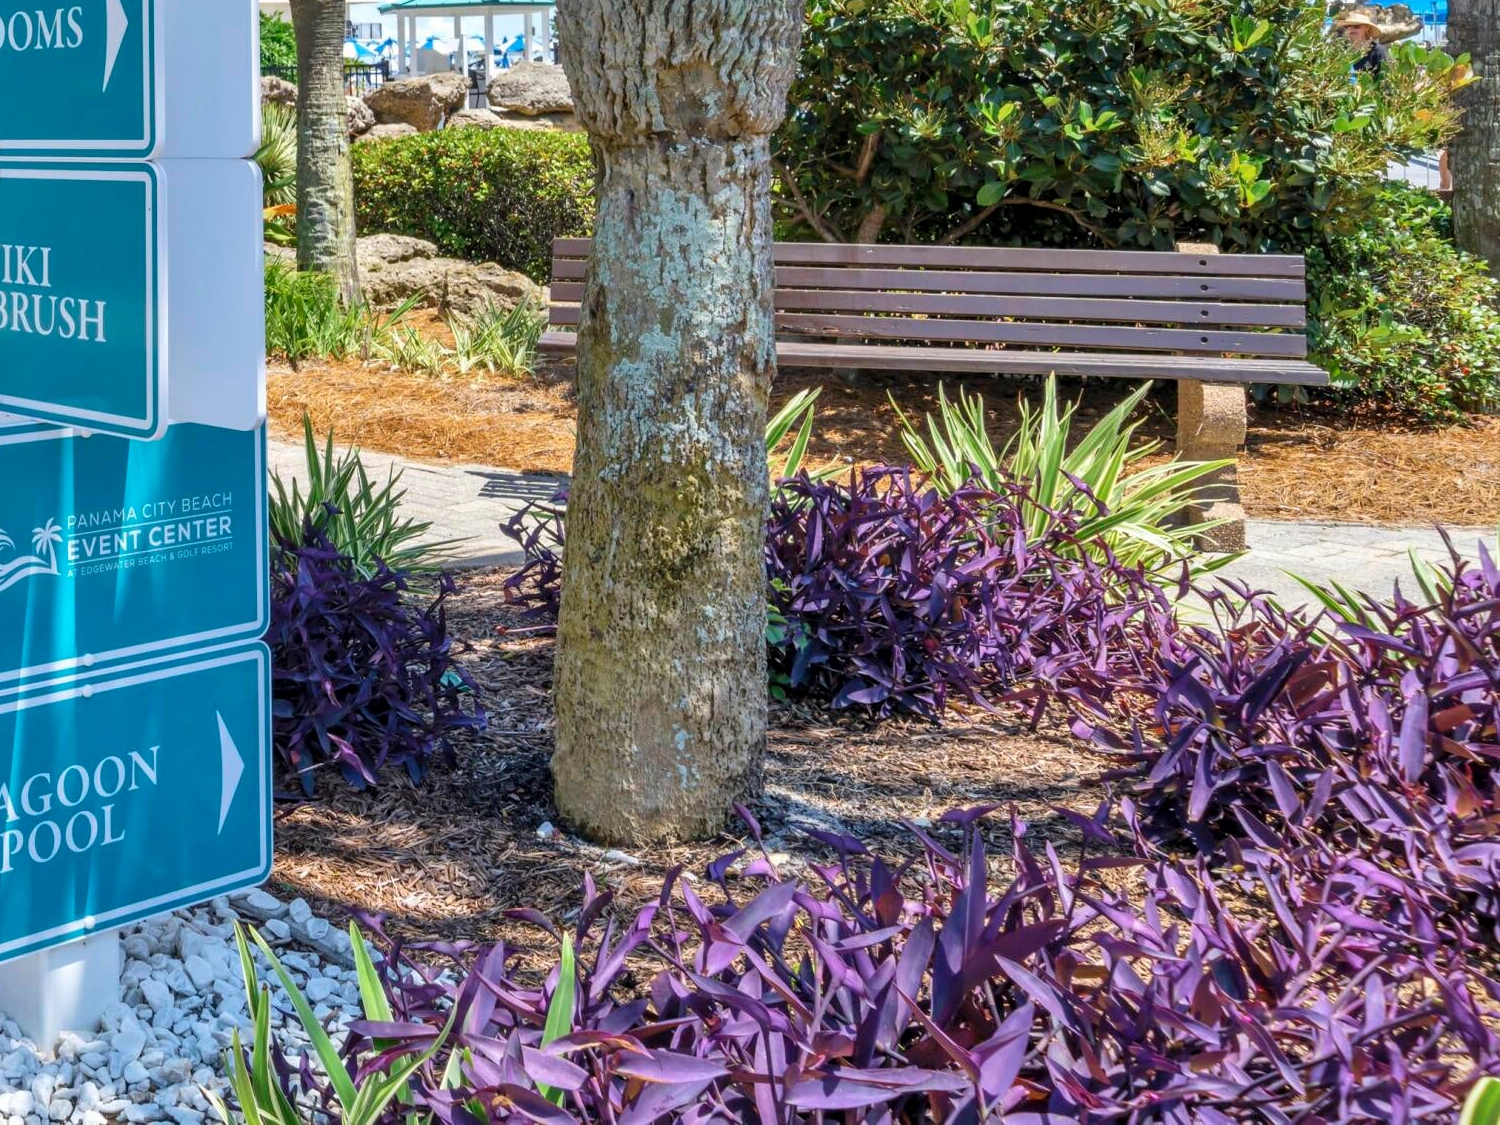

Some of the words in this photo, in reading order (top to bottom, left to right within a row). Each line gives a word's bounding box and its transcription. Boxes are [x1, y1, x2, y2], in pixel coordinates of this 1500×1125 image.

[67, 506, 137, 530] PANAMA
[142, 500, 176, 518] CITY
[182, 491, 233, 512] BEACH
[67, 529, 142, 561] EVENT
[148, 516, 232, 546] CENTER
[81, 558, 136, 576] EDGEWATER
[138, 553, 167, 566] BEACH
[177, 547, 200, 559] GOLF
[201, 542, 233, 556] RESORT
